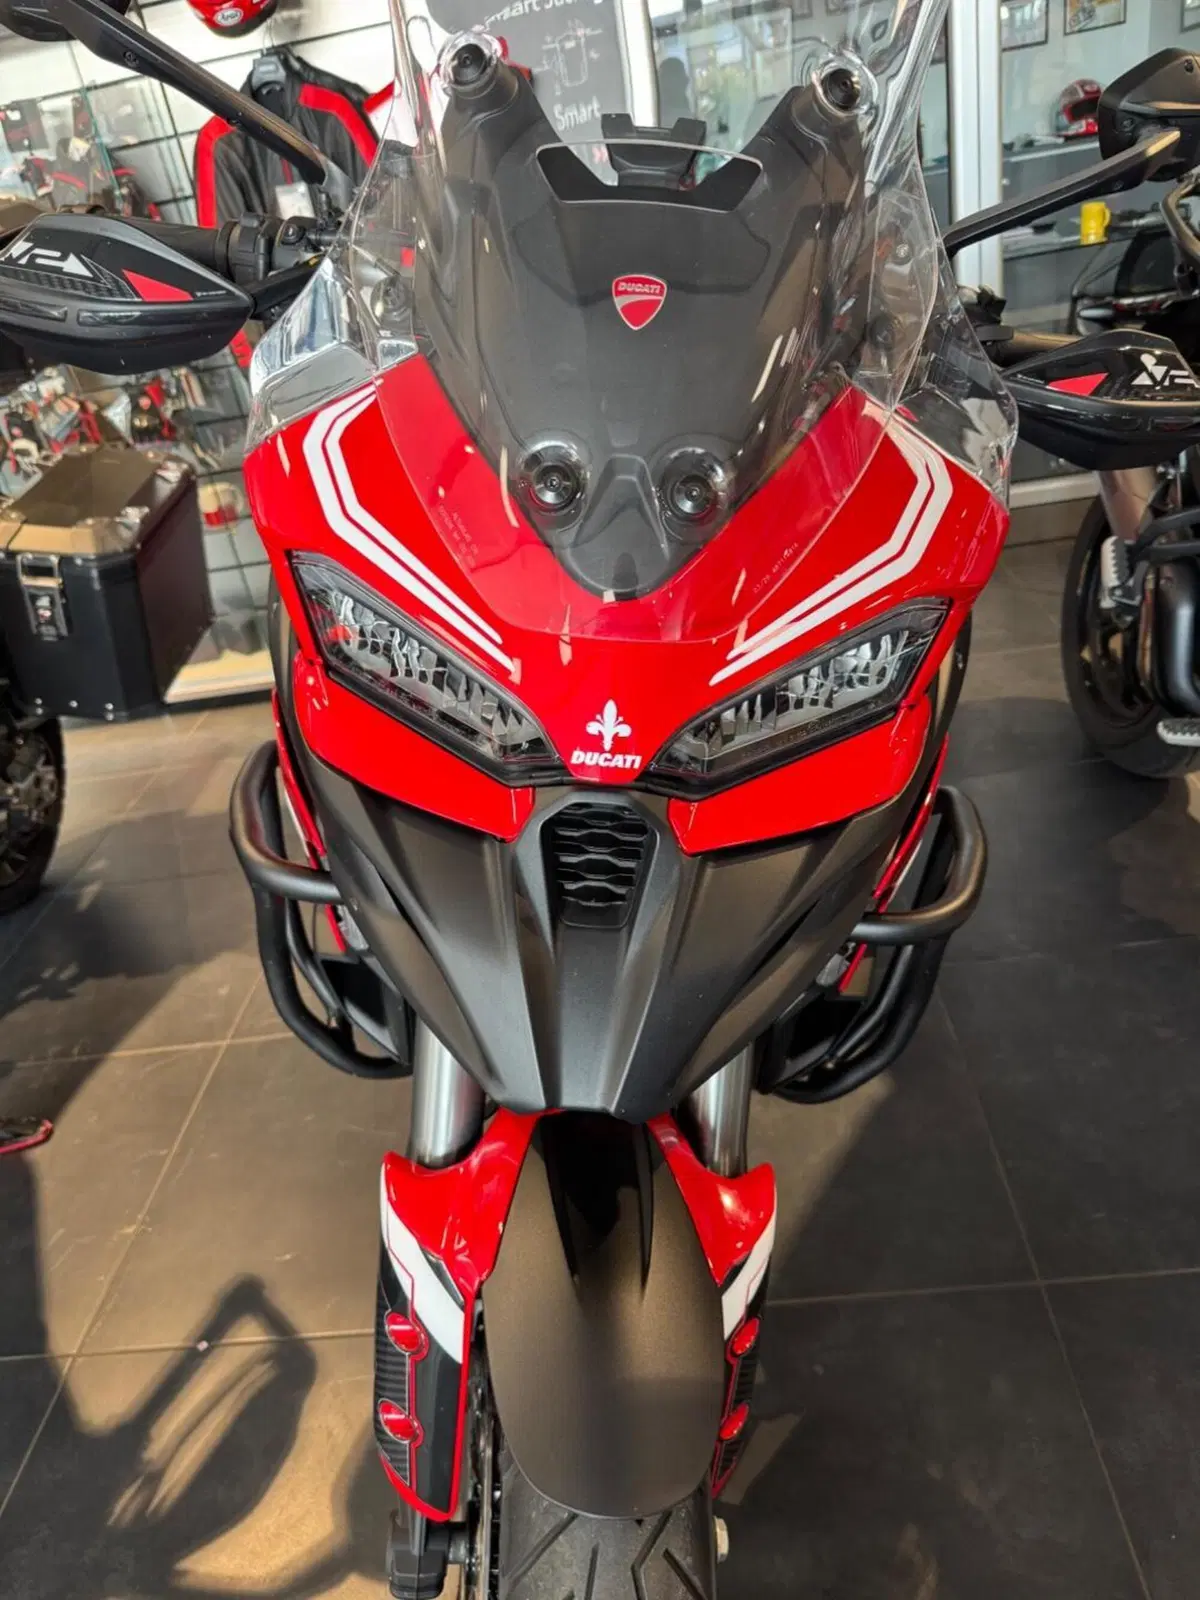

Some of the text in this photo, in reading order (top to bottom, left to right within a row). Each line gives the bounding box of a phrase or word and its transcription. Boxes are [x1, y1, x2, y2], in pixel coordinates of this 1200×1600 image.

[553, 96, 601, 131] Smart
[617, 281, 661, 294] DUCATI
[570, 750, 642, 769] DUCATI
